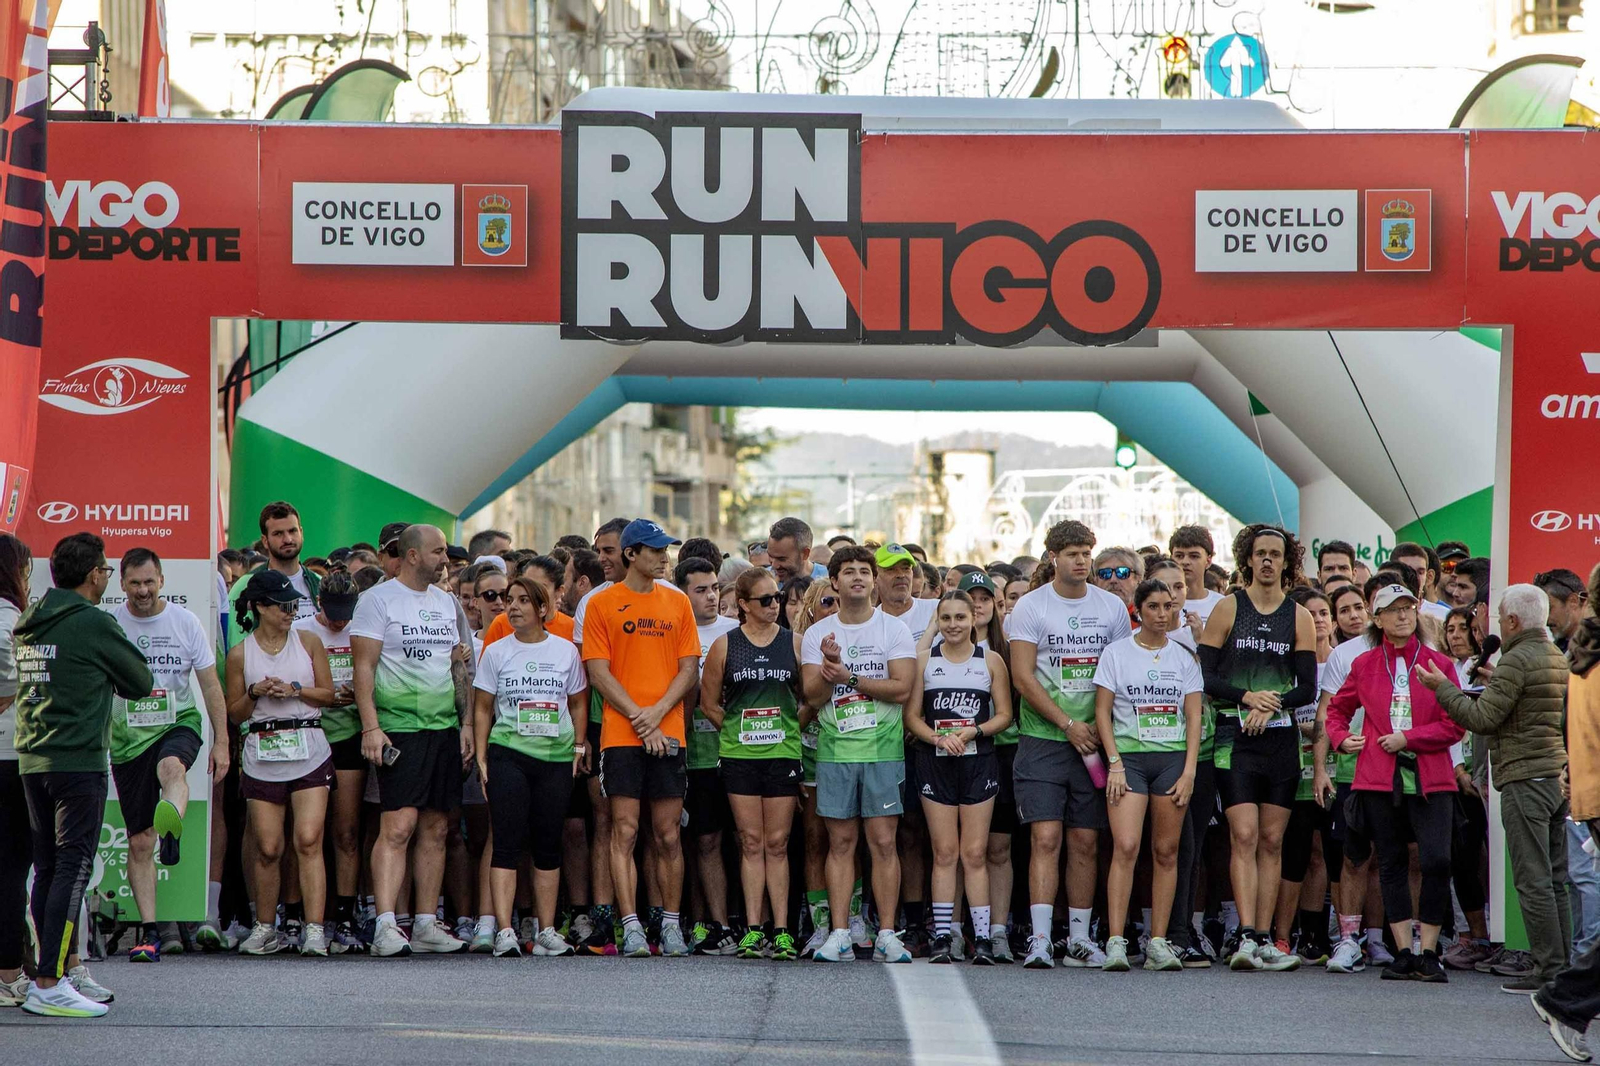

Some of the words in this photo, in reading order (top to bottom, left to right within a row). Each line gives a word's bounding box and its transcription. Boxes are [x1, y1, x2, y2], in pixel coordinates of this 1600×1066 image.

[577, 125, 849, 223] RUN
[45, 180, 180, 229] VIGO
[304, 200, 442, 221] CONCELLO
[1207, 207, 1345, 228] CONCELLO
[1490, 191, 1600, 240] VIG
[321, 226, 354, 246] DE
[363, 226, 426, 247] VIGO
[1223, 233, 1257, 253] DE
[1266, 234, 1329, 253] VIGO
[49, 227, 241, 262] DEPORTE
[41, 378, 90, 394] Frutas
[139, 378, 187, 395] Nieves
[84, 504, 189, 521] HYUNDAI
[101, 526, 148, 537] Hyupersa
[149, 526, 172, 537] Vigo
[401, 624, 419, 636] En
[1047, 634, 1064, 645] En
[1067, 633, 1108, 645] Marcha
[1236, 636, 1259, 649] máis
[1266, 641, 1290, 655] auga
[145, 653, 182, 666] archa
[402, 646, 432, 661] Vigo
[844, 660, 884, 673] Marcha
[1070, 668, 1093, 678] 1097
[733, 667, 757, 683] máis
[766, 669, 791, 682] auga
[504, 677, 519, 687] En
[521, 676, 564, 688] Marcha
[834, 685, 854, 697] igo
[1126, 684, 1141, 695] En
[134, 701, 160, 711] 2550
[843, 706, 867, 717] 1906
[528, 712, 551, 722] 2812
[1147, 716, 1170, 726] 1096
[750, 720, 774, 730] 1905
